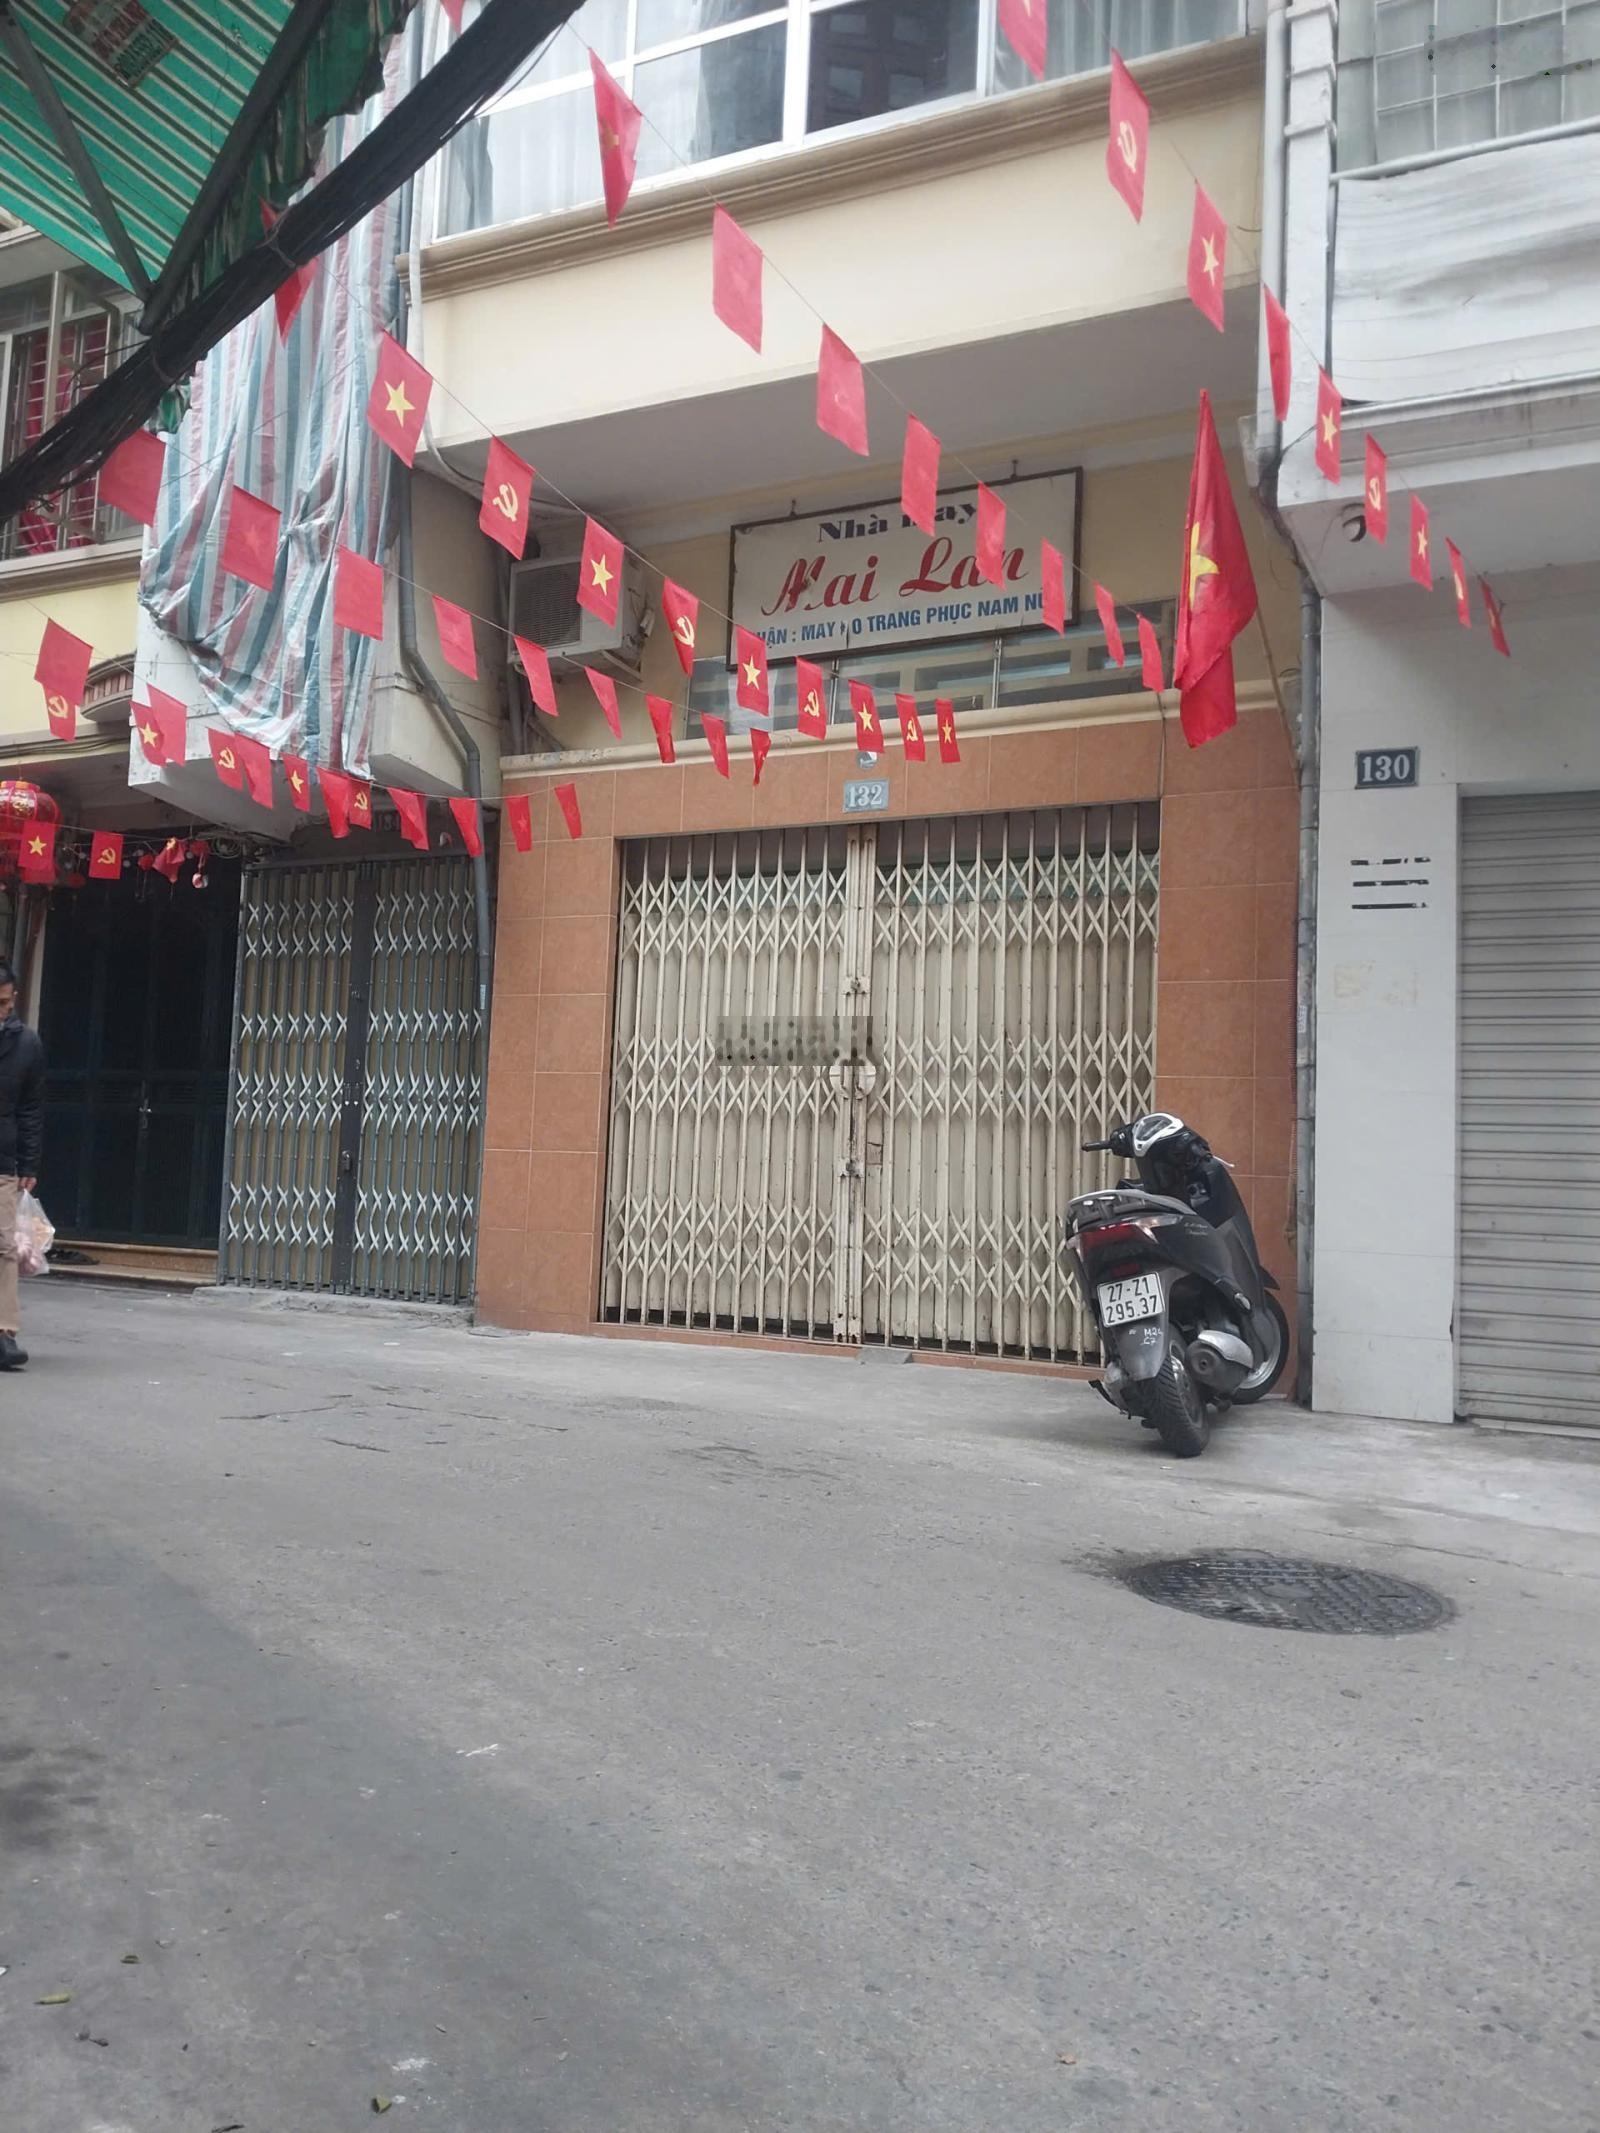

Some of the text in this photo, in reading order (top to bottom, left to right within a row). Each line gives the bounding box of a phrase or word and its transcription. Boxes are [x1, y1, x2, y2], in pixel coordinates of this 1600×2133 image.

[818, 513, 888, 543] Nhà
[802, 621, 835, 641] MAY
[867, 610, 921, 632] TRANG
[926, 602, 972, 624] PHỤC
[977, 596, 1018, 617] NAM
[1362, 754, 1411, 782] 130
[848, 784, 882, 807] 132
[1105, 1294, 1157, 1324] 295.37
